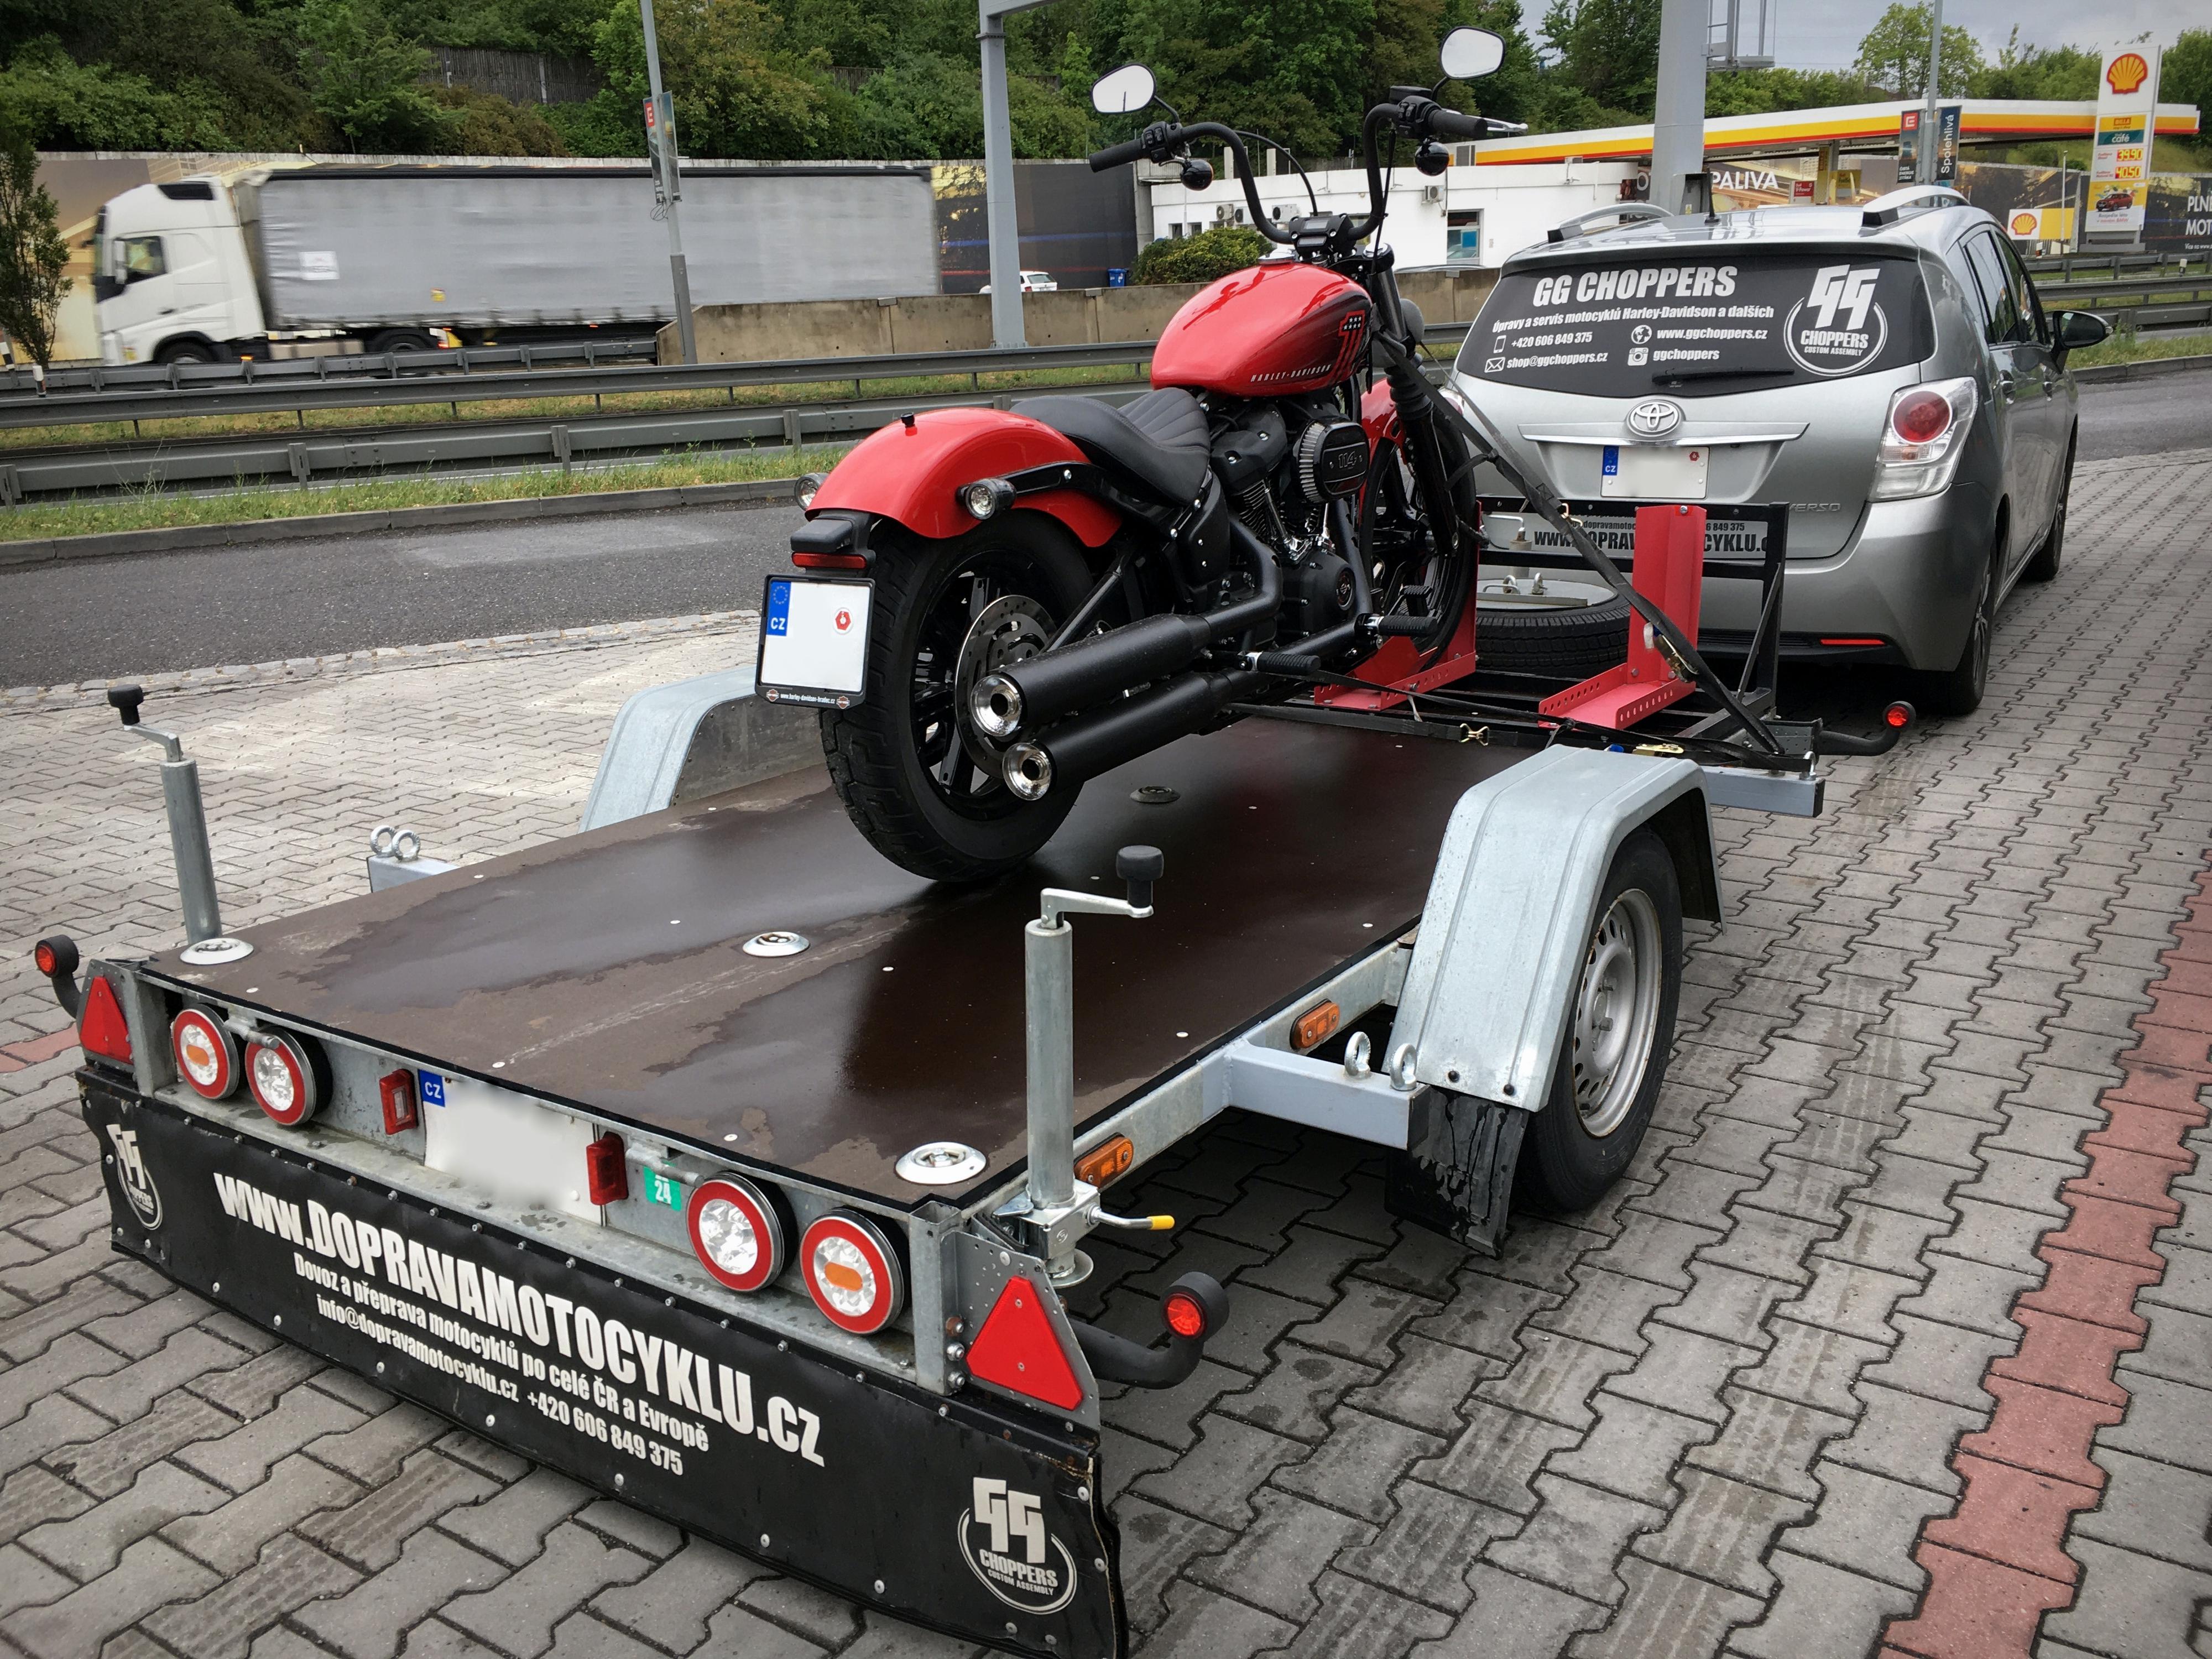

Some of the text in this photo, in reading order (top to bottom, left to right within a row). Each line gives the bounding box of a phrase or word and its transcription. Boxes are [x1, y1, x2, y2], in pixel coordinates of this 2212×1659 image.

[1941, 114, 1954, 174] Spolehlivá
[2111, 133, 2130, 143] café
[1712, 170, 1779, 190] PALIVA
[1533, 266, 1738, 307] GG CHOPPERS
[1492, 305, 1774, 333] Úpravy a servis motocyklů Harley-Davidson a dalších
[1511, 332, 1593, 348] +420 606 849 375
[1657, 327, 1768, 340] www.ggchoppers.cz
[1801, 330, 1869, 349] CHOPPERS
[1506, 352, 1608, 369] shop@ggchoppers.cz
[1652, 348, 1720, 361] ggchoppers
[1804, 346, 1864, 356] CUSTOM ASSEMBLY
[1338, 451, 1357, 469] 114
[1713, 523, 1729, 531] 849
[1730, 523, 1745, 531] 375
[770, 616, 785, 630] CZ
[424, 1081, 442, 1100] CZ
[655, 1180, 671, 1204] 24
[213, 1172, 825, 1467] WWW.DOPRAVAMOTOCYKLU.CZ
[294, 1251, 709, 1452] Dovoz a přeprava motocyklů po celé ČR a Evropě
[317, 1293, 684, 1477] info@dopravamotocyklu.cz +420 606 849 375
[979, 1548, 1058, 1588] CHOPPERS
[988, 1569, 1055, 1596] CUSTOM ASSEMBLY
